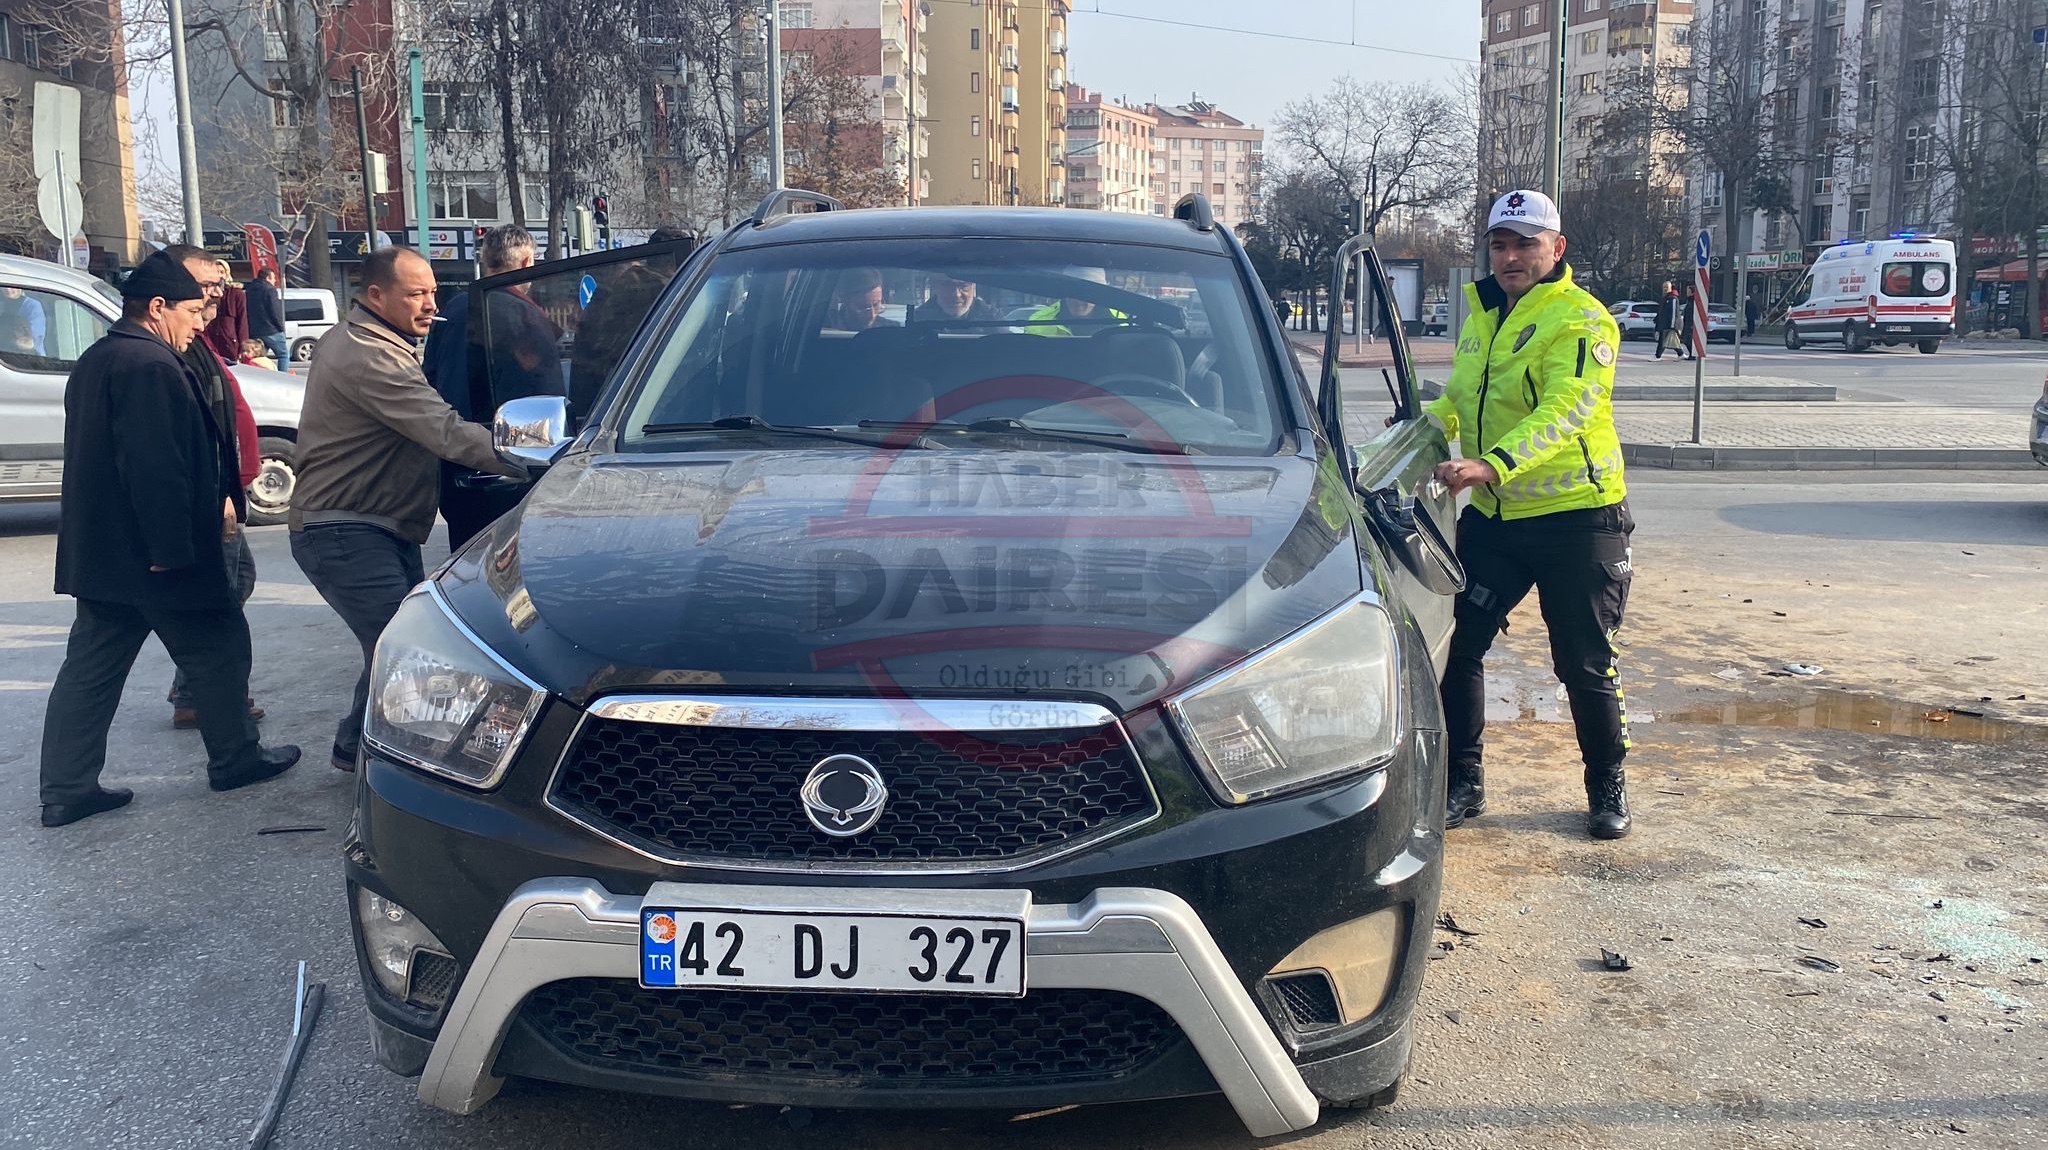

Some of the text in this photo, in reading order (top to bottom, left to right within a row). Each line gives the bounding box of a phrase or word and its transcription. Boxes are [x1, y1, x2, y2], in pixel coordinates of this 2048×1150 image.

[1457, 335, 1481, 356] PLİS
[647, 921, 1011, 984] TR 42 DJ 327
